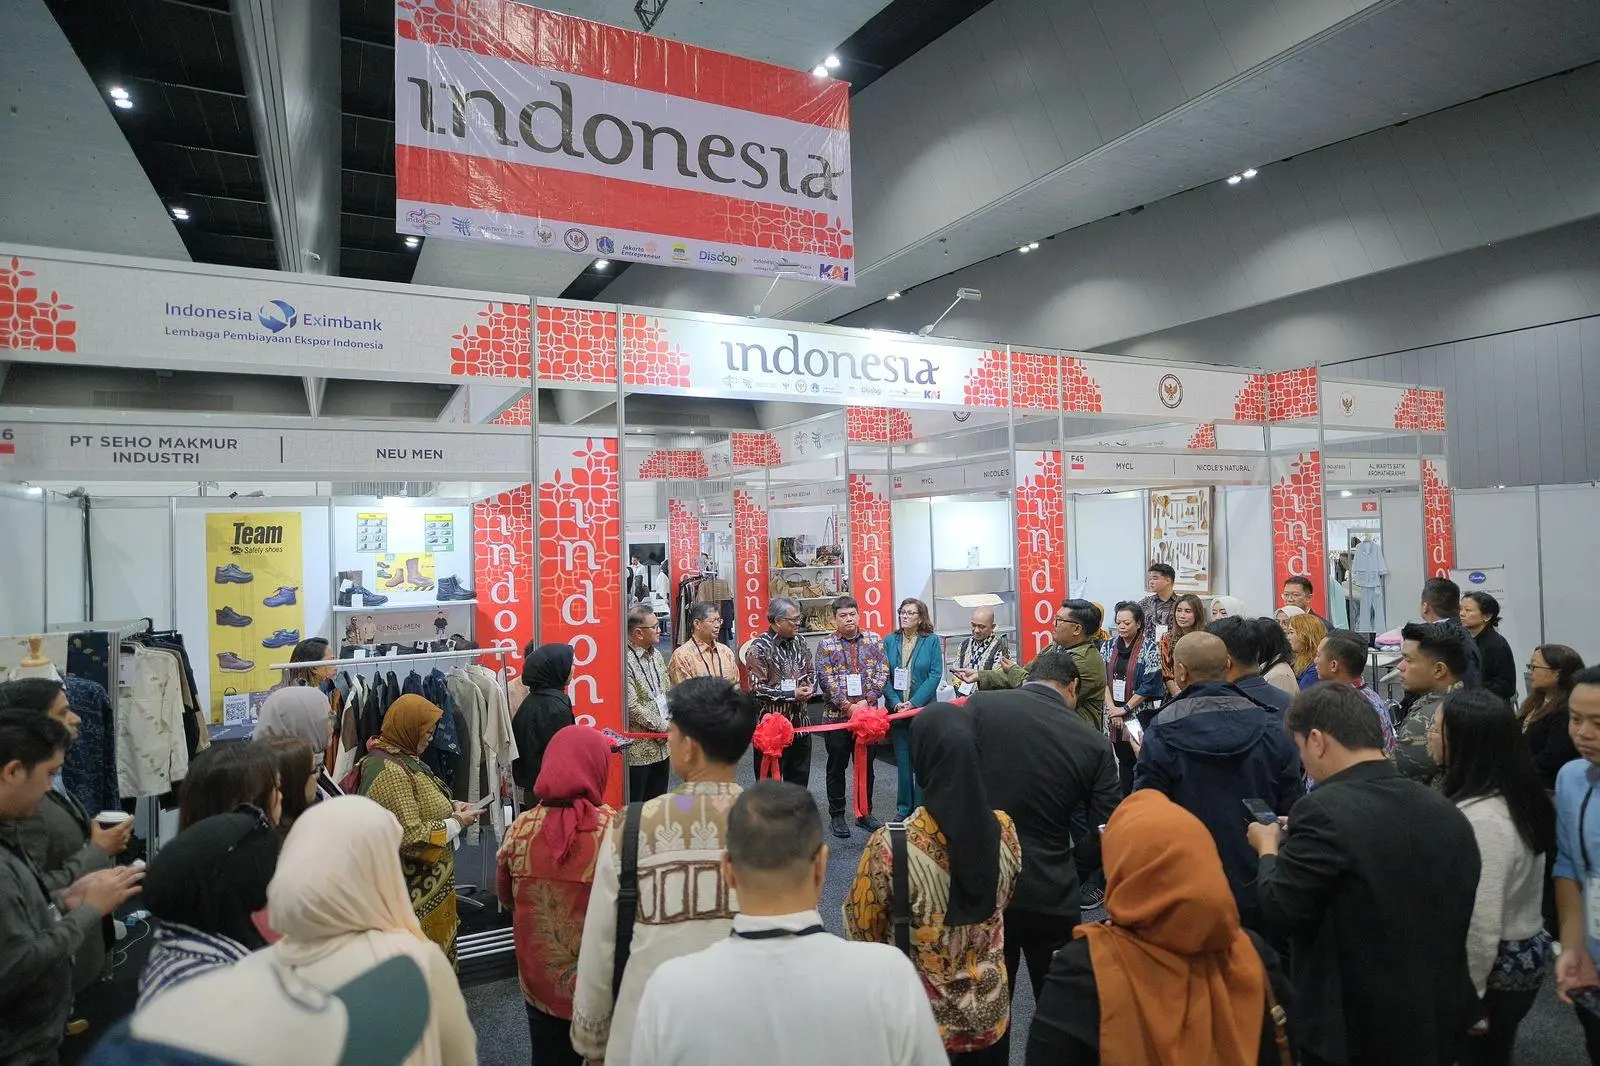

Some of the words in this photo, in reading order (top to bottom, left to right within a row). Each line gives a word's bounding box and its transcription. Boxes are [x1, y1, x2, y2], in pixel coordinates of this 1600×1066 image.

[407, 76, 845, 201] indonesia
[622, 244, 645, 252] Jakarta
[621, 249, 661, 260] Entrepreneur
[165, 302, 252, 321] Indonesia
[303, 313, 383, 331] Eximbank
[165, 326, 220, 340] Lembaga
[223, 330, 292, 345] Pembiayaan
[294, 335, 331, 348] Ekspor
[333, 338, 384, 351] Indonesia
[721, 333, 940, 385] indonesia
[0, 429, 14, 440] 6
[70, 435, 94, 447] PT
[100, 436, 152, 449] SEHO
[158, 437, 238, 450] MAKMUR
[113, 451, 200, 464] INDUSTRI
[376, 448, 407, 459] NEU
[412, 449, 443, 460] MEN
[1071, 455, 1084, 463] F45
[1115, 462, 1134, 470] MYCL
[1196, 464, 1224, 472] NICOLE'S
[1224, 464, 1251, 472] NATURAL
[983, 469, 1010, 479] NICOLE'S
[644, 523, 657, 531] F37
[232, 522, 283, 545] Team
[244, 546, 264, 555] Safety
[264, 545, 284, 553] shoes
